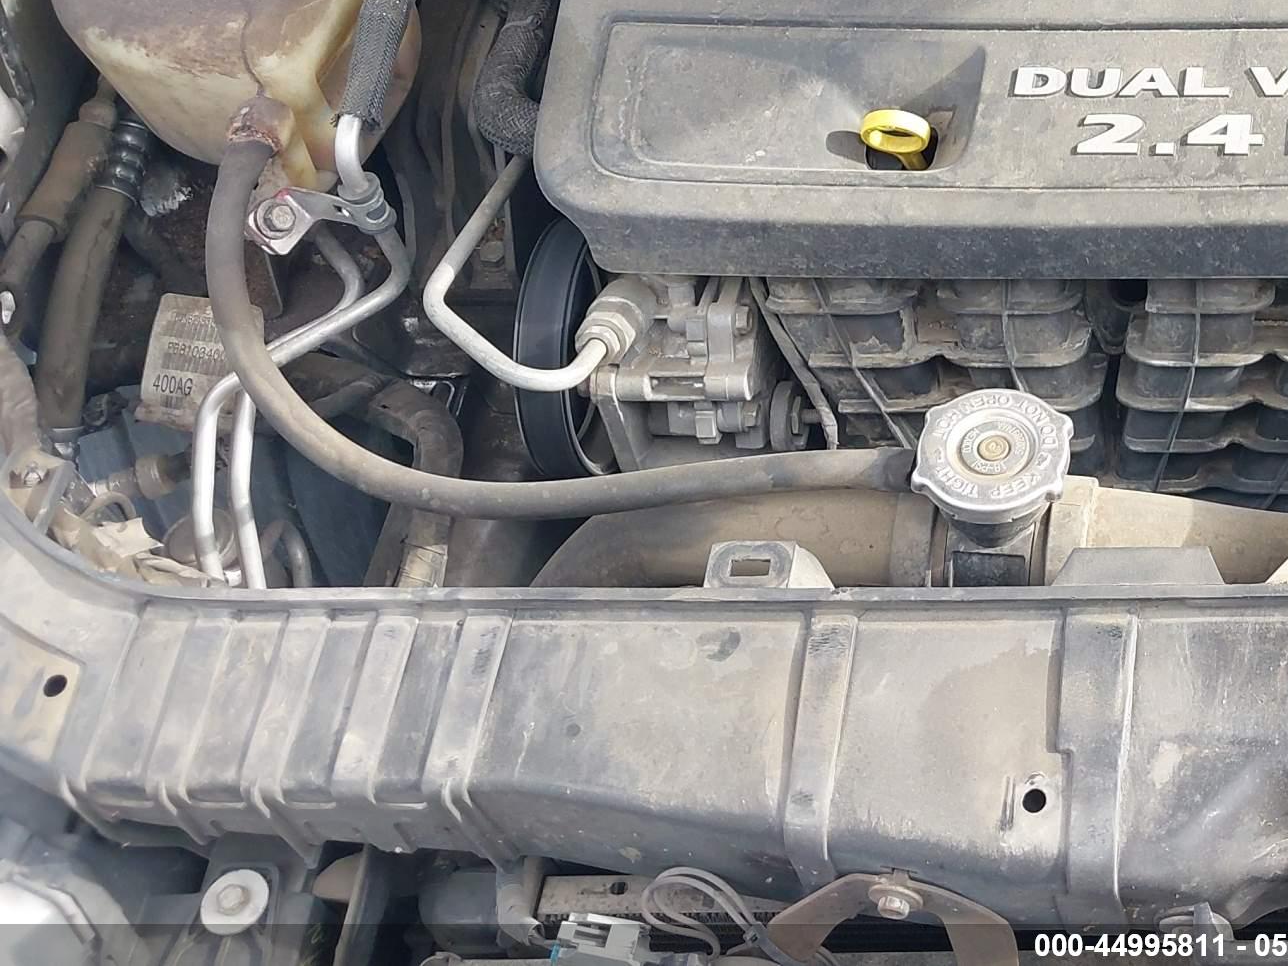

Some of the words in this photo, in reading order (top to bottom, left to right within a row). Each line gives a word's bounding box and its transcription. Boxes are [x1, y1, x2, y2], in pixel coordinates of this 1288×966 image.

[1008, 65, 1230, 98] DUAL
[153, 374, 193, 396] 400AG
[959, 394, 1012, 414] OPEN
[1016, 400, 1050, 429] NOT
[932, 410, 962, 441] HOT
[935, 466, 979, 498] TIGHT
[991, 473, 1041, 498] KEEP
